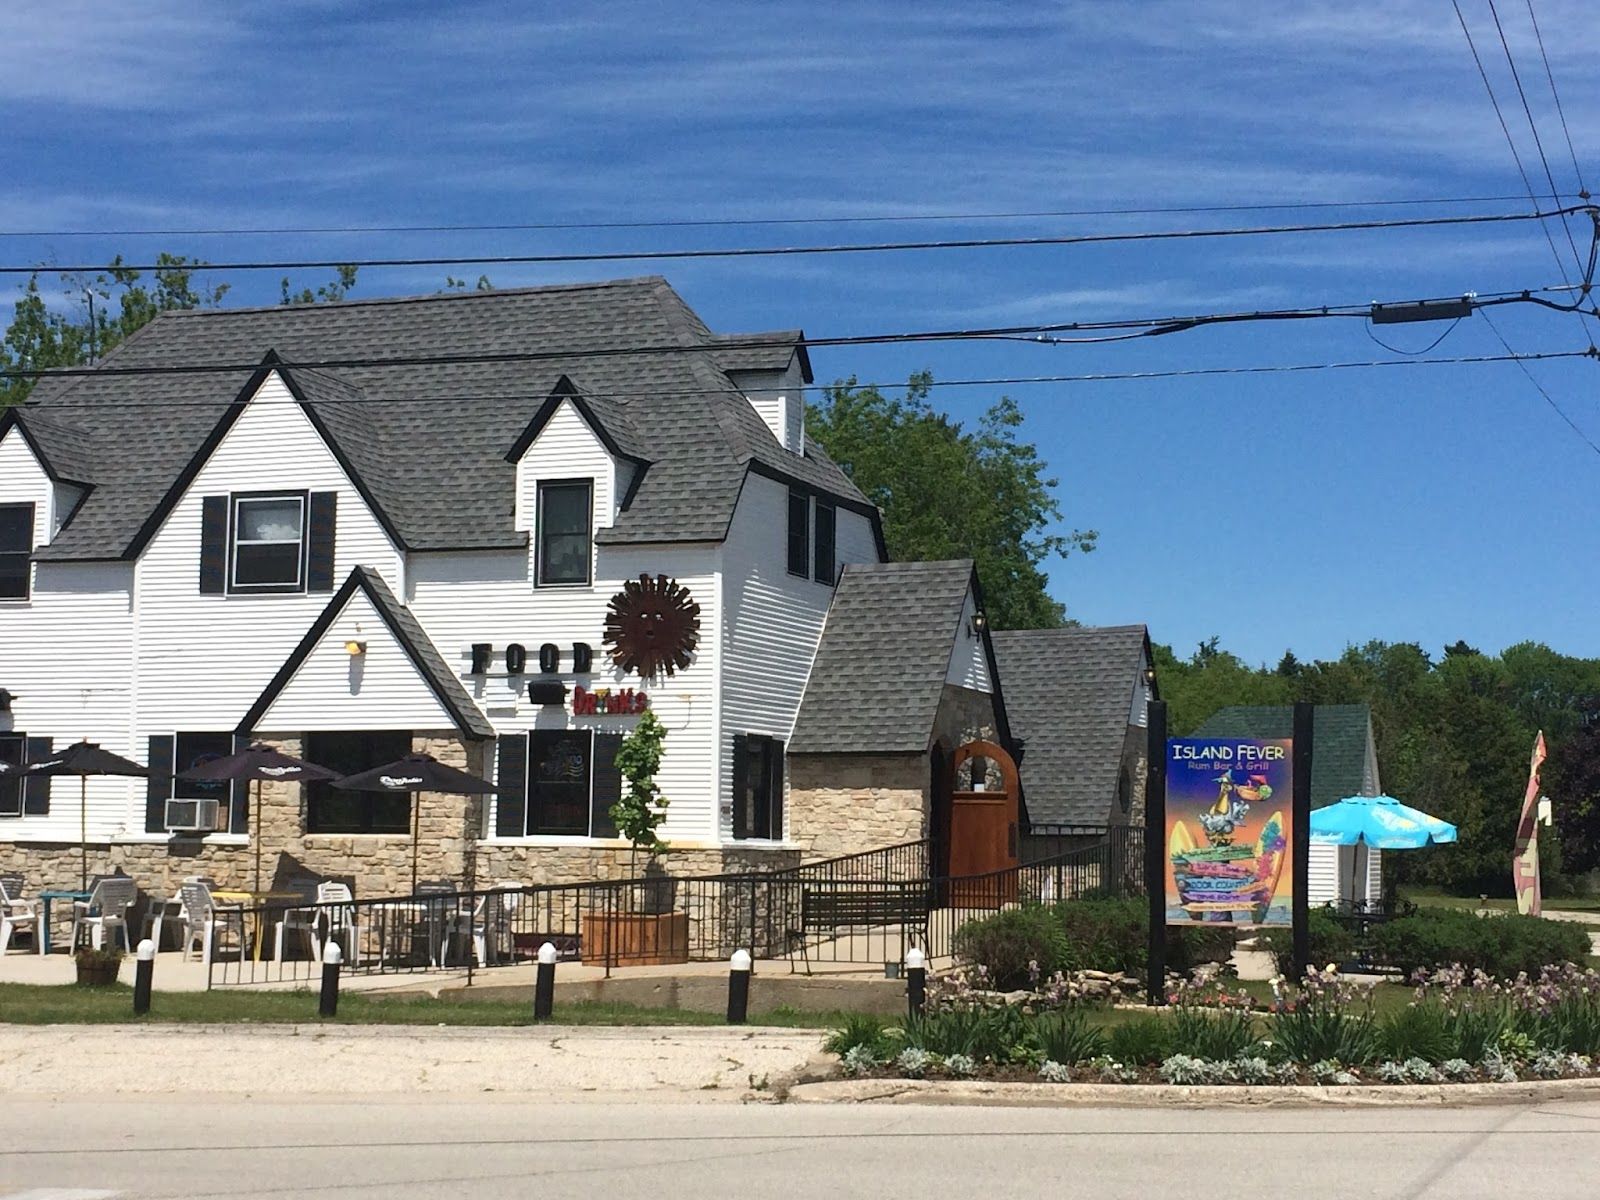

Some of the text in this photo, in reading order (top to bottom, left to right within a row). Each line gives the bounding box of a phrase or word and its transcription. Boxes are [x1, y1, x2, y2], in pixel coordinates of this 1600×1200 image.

[471, 642, 593, 674] FOOD
[1172, 744, 1285, 761] ISLAND FEVER
[1187, 761, 1211, 770] Rum
[1213, 761, 1232, 770] Bar
[1246, 761, 1270, 770] Grill
